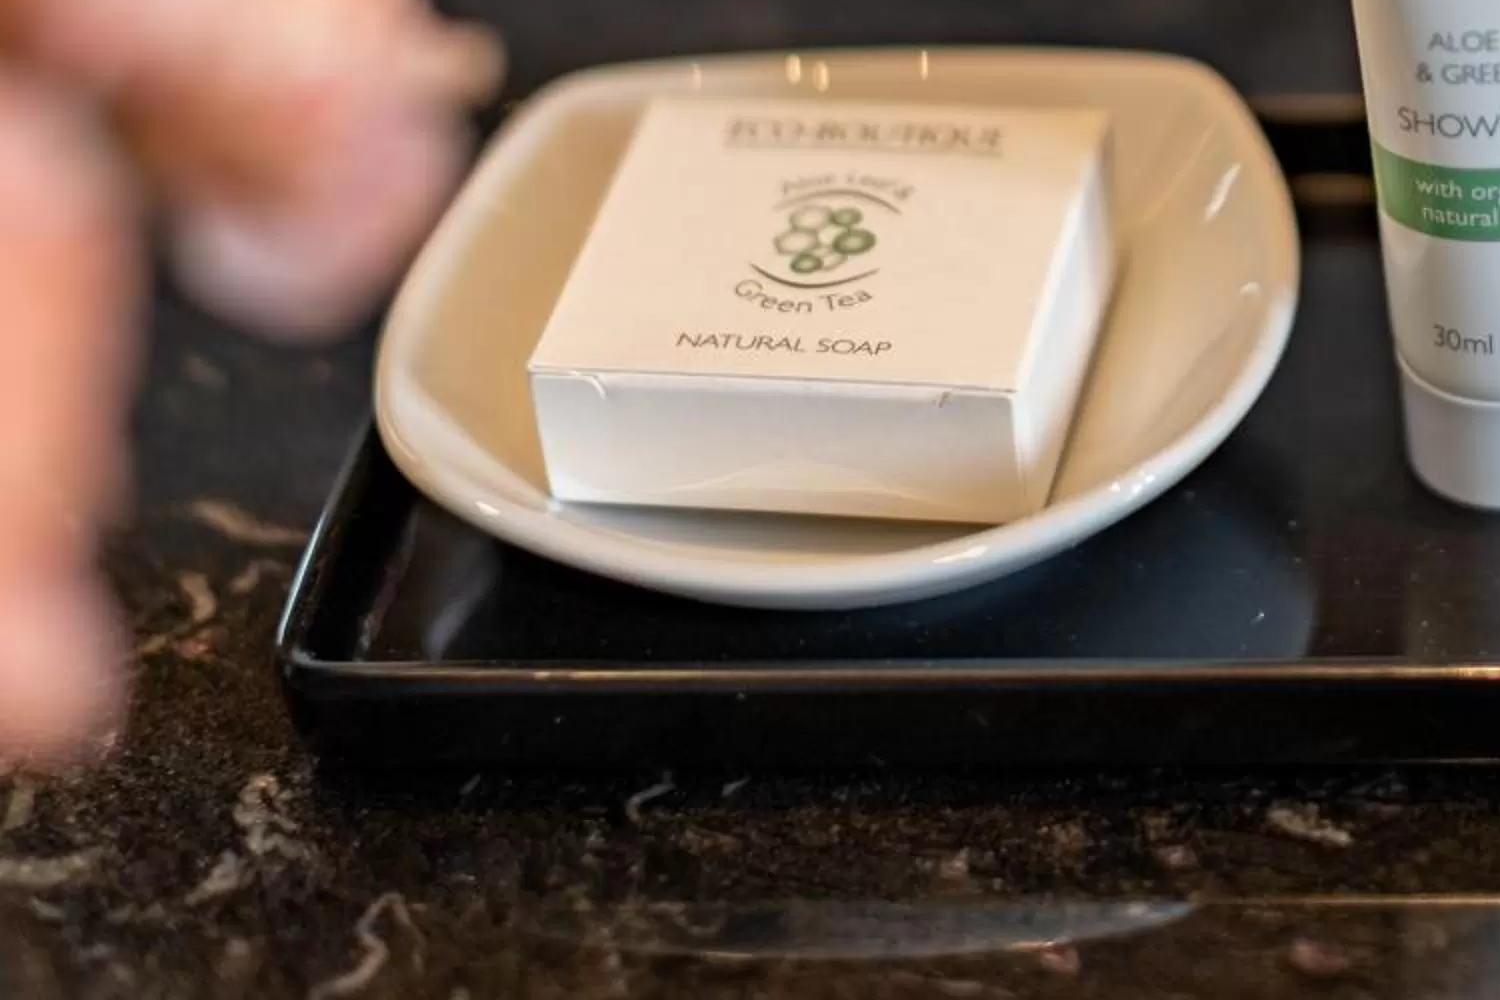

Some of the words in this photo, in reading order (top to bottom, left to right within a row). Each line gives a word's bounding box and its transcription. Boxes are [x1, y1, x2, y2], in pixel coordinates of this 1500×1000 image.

[1428, 28, 1499, 53] ALOE
[1415, 64, 1433, 84] &
[1415, 176, 1463, 199] with
[1421, 204, 1499, 227] natural
[733, 280, 813, 314] Green
[825, 290, 873, 312] Tea
[676, 332, 805, 353] NATURAL
[817, 337, 892, 357] SOAP
[1433, 324, 1494, 355] 30ml
